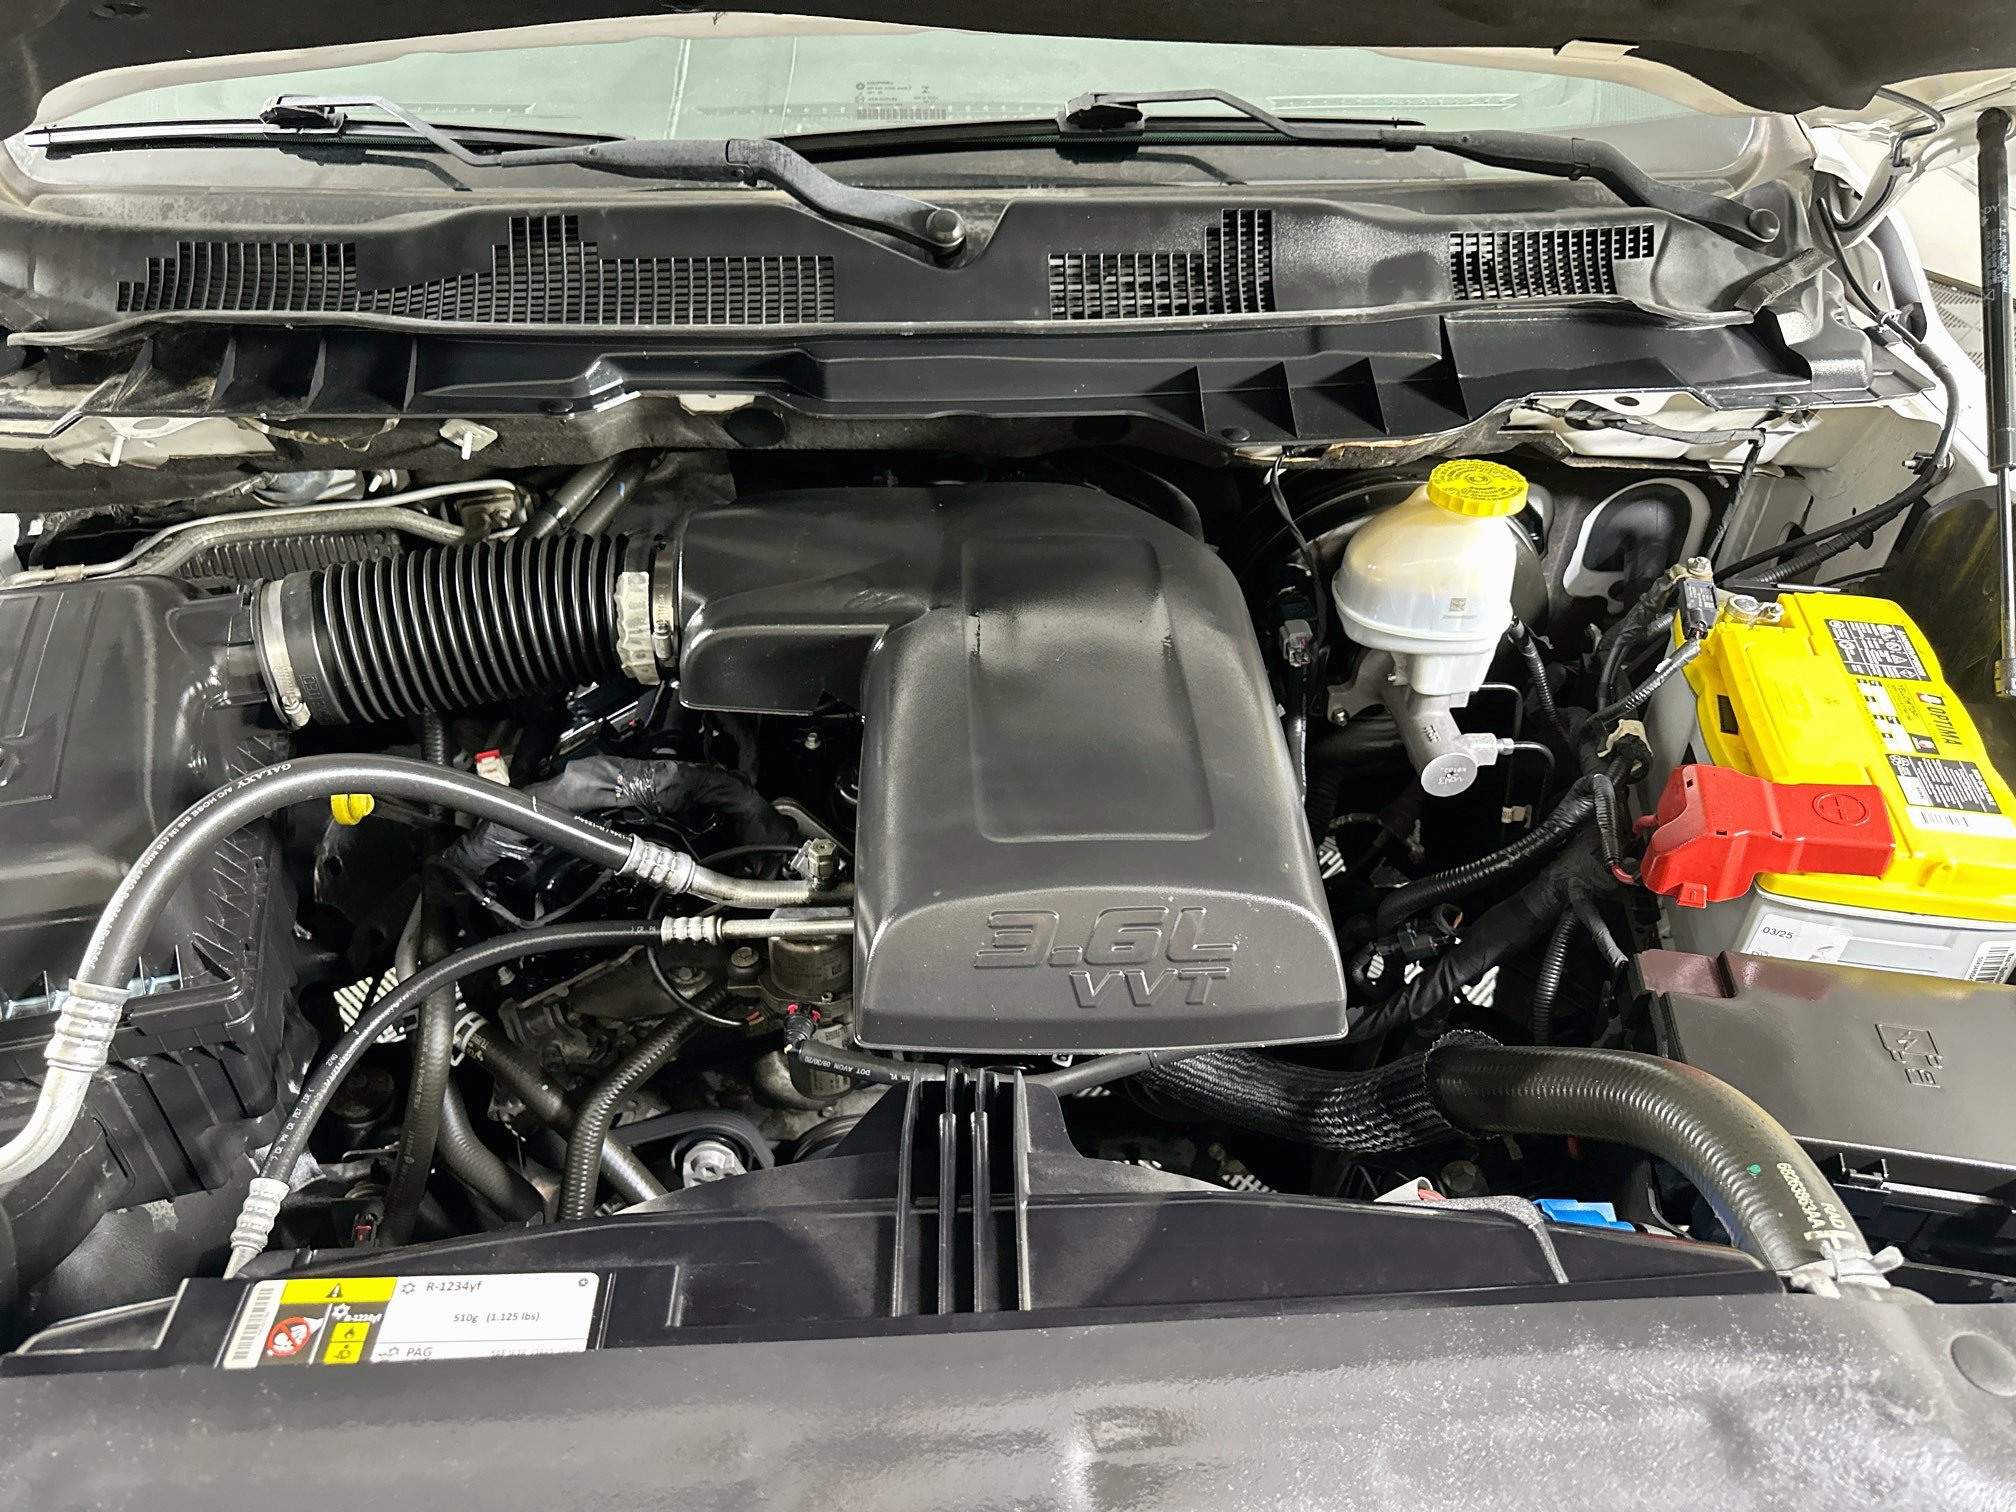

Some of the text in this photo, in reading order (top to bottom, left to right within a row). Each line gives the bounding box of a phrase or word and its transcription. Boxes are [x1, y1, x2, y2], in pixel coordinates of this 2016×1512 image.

[1927, 706, 1963, 745] OPTIMA
[237, 763, 292, 789] GALAXY
[217, 787, 233, 799] A/C
[192, 797, 218, 818] HOSE
[168, 828, 180, 838] IN
[973, 906, 1237, 968] 3.6L
[1762, 926, 1794, 939] 03/25
[1069, 965, 1231, 1008] VVT
[326, 1053, 338, 1067] 2740
[804, 1055, 831, 1068] 09/30/20
[833, 1063, 854, 1073] AVON
[855, 1068, 871, 1076] DOT
[1776, 1162, 1826, 1228] 68263863AA
[1821, 1202, 1846, 1230] RAD
[426, 1280, 482, 1295] R-1234yf
[453, 1310, 540, 1324] 510g (1.125 lbs)
[406, 1346, 433, 1358] PAG
